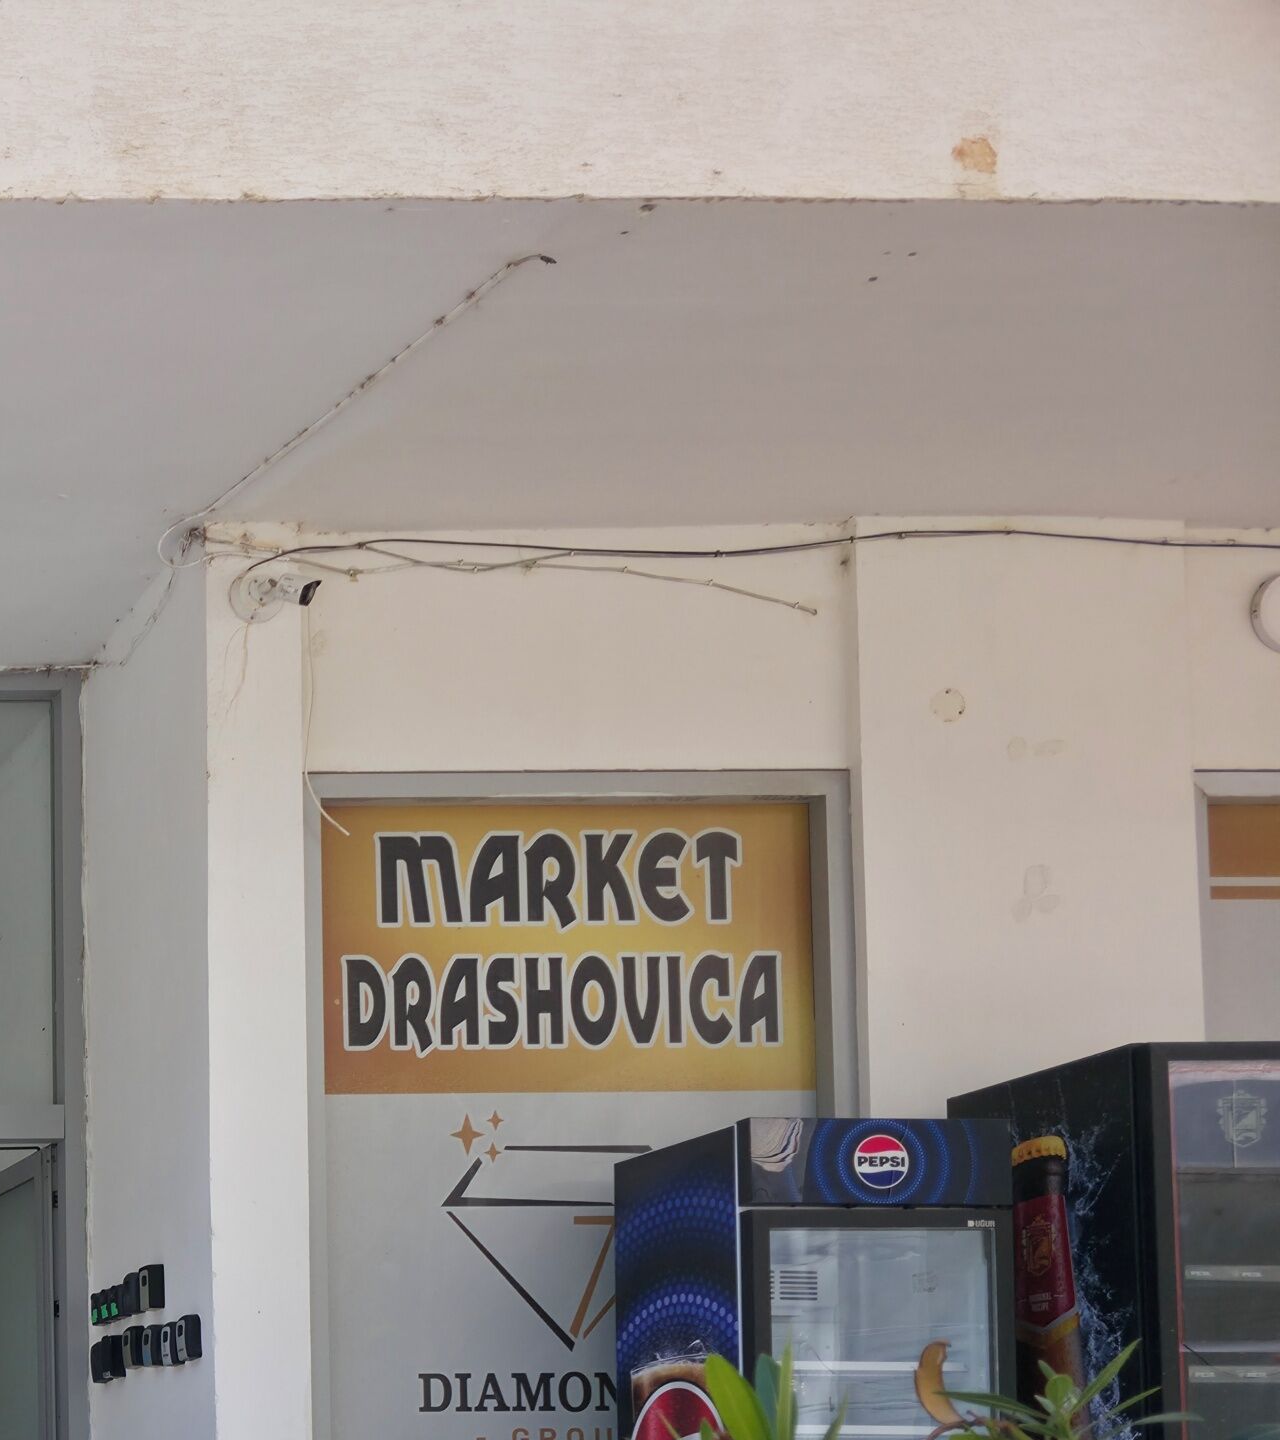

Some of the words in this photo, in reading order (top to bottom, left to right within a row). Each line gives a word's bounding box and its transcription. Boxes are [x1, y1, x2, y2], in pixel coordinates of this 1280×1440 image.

[375, 829, 741, 930] MARKET
[342, 953, 781, 1057] DRASHOVICA
[857, 1155, 906, 1168] PEPSI
